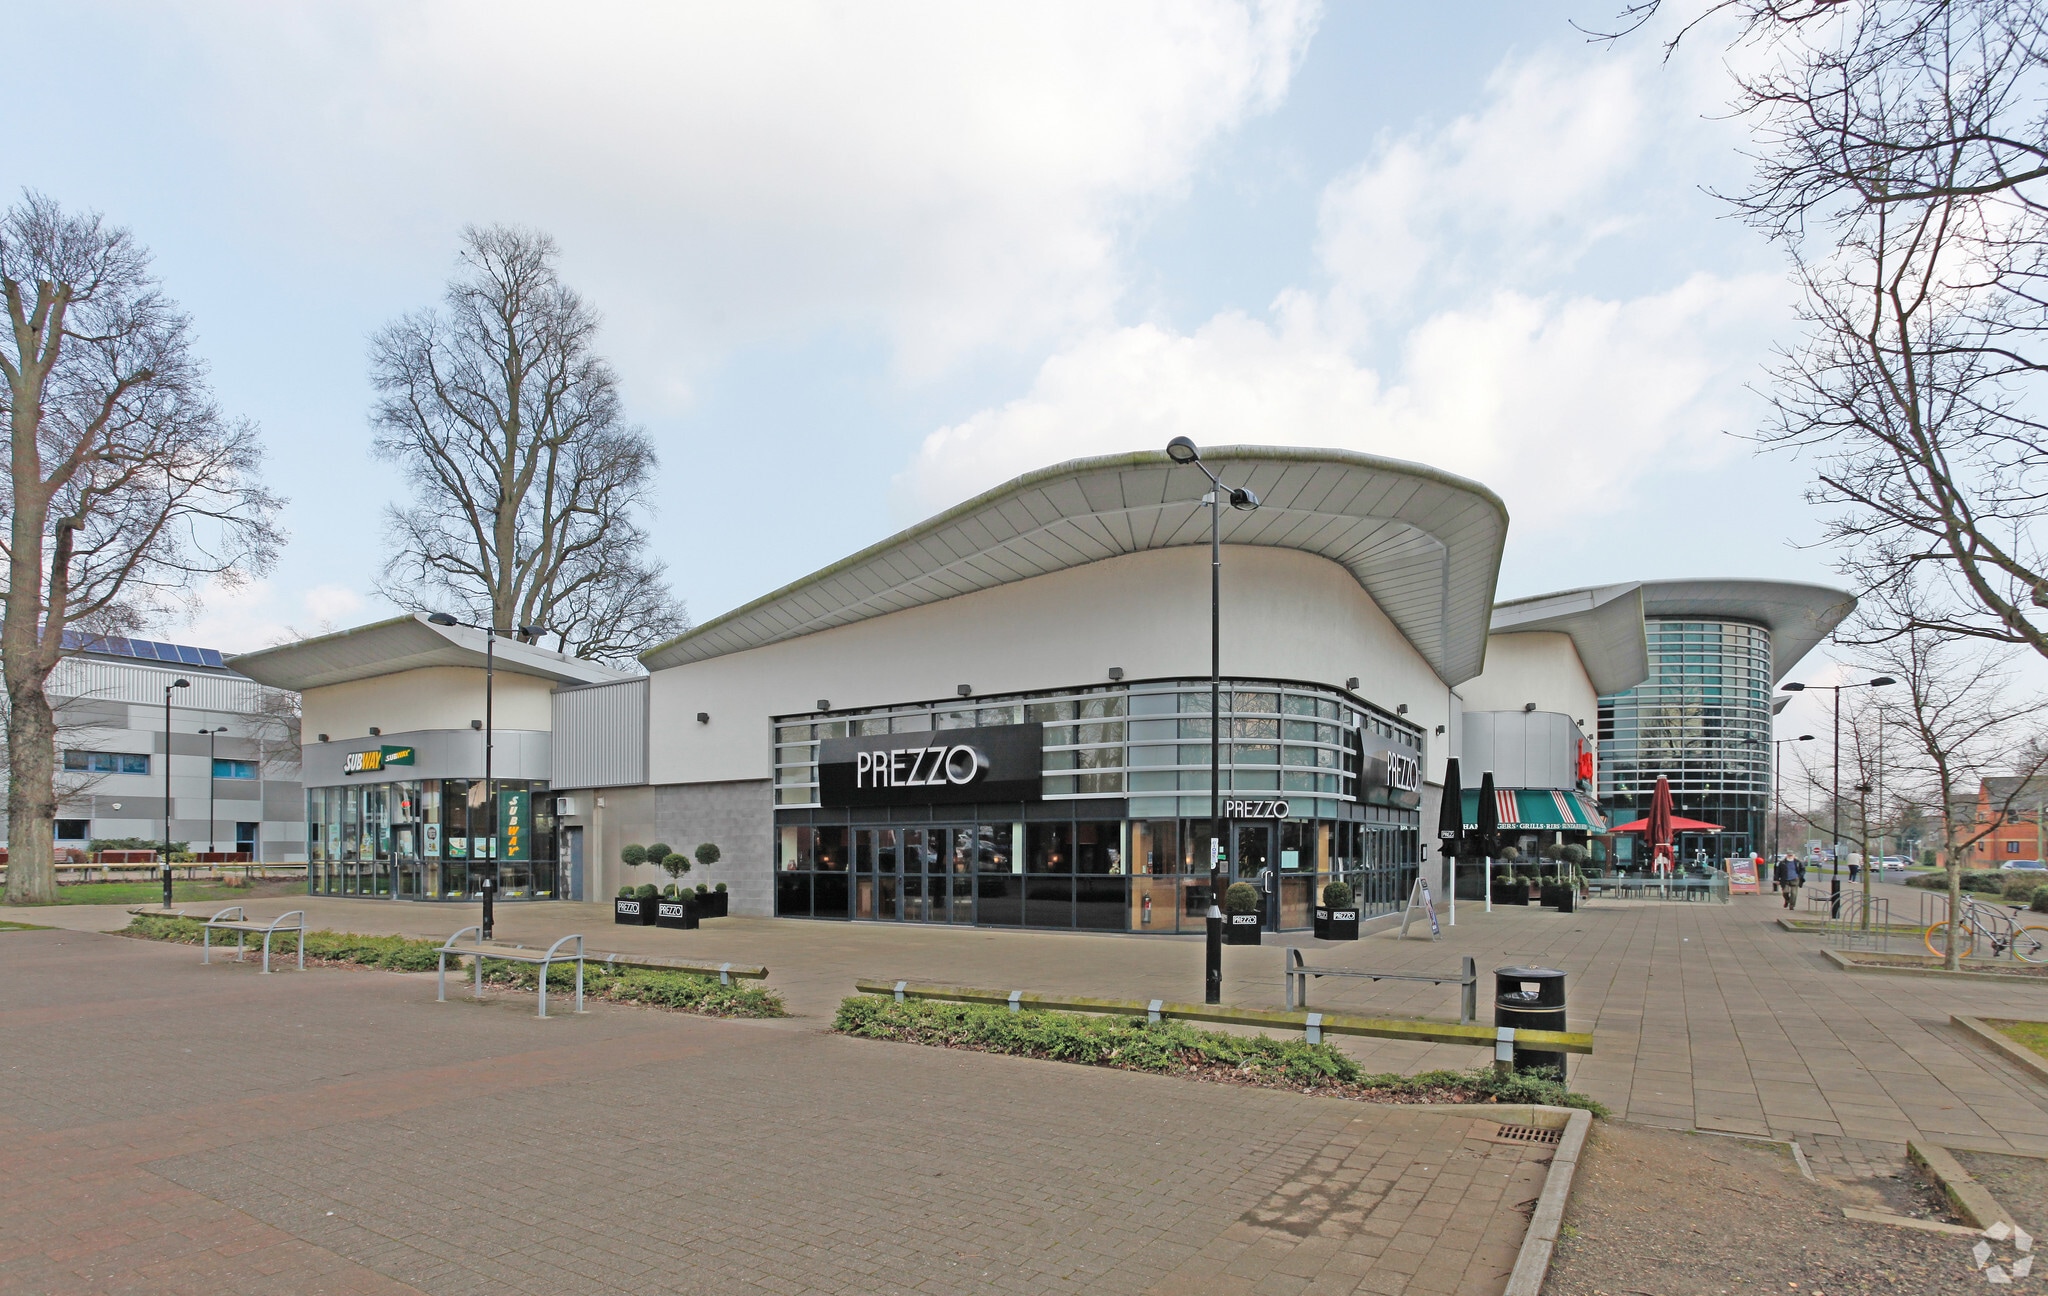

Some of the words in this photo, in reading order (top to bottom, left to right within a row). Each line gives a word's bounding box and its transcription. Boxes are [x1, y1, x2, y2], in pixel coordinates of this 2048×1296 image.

[344, 751, 382, 771] SUBWAY
[385, 749, 411, 762] SUBWAY
[857, 745, 978, 788] PREZZO
[1387, 750, 1418, 792] PREZZO
[1226, 800, 1289, 818] PREZZO
[508, 796, 520, 856] SUBWAY
